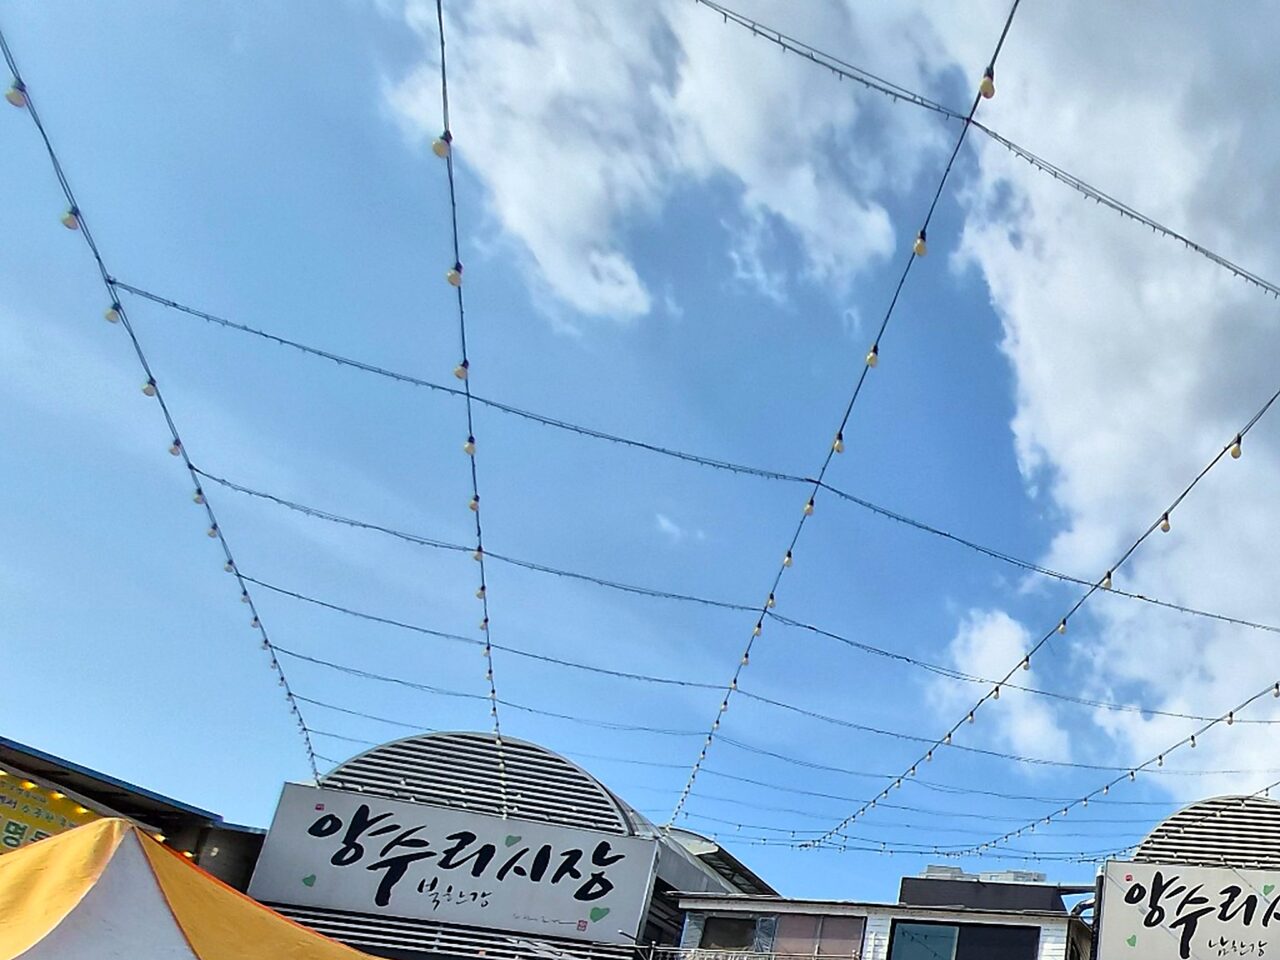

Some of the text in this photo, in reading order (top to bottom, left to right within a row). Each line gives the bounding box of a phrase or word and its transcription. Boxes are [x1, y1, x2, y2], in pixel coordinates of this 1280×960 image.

[308, 804, 625, 906] 양수리시장
[418, 877, 492, 910] 북한강
[1208, 936, 1267, 957] 남한강
